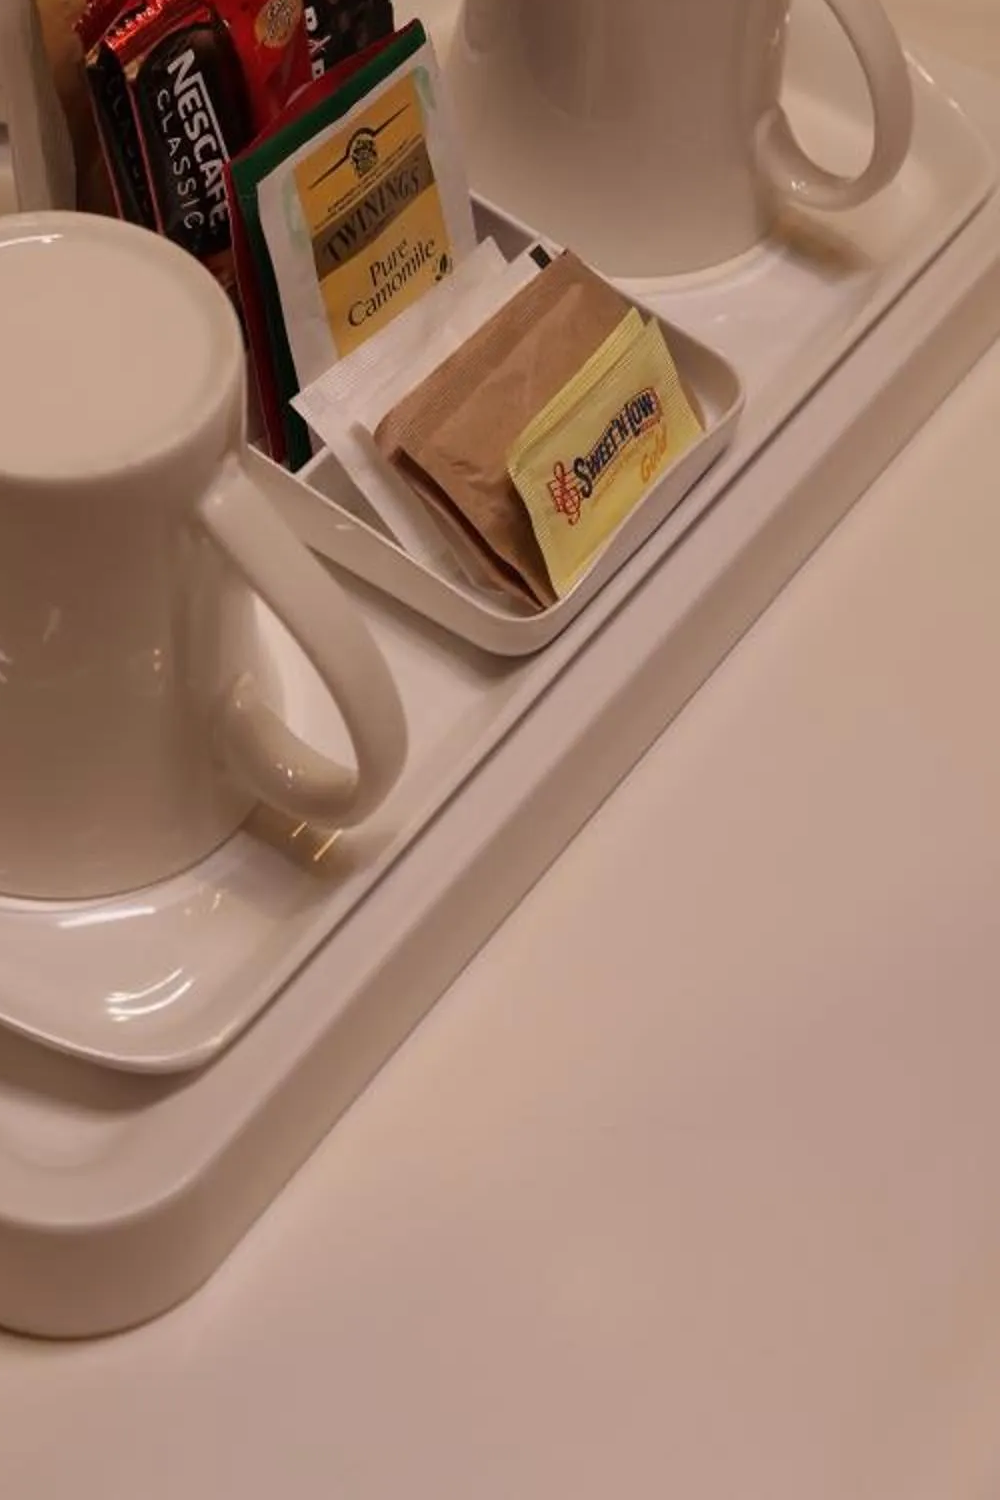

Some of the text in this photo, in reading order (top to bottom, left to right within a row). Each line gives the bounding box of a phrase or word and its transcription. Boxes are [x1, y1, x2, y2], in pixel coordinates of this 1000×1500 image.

[155, 88, 204, 230] CLASSIC
[322, 167, 421, 263] TWININGS
[347, 238, 436, 327] Camomile
[368, 238, 409, 287] Pure
[641, 424, 667, 482] Gold
